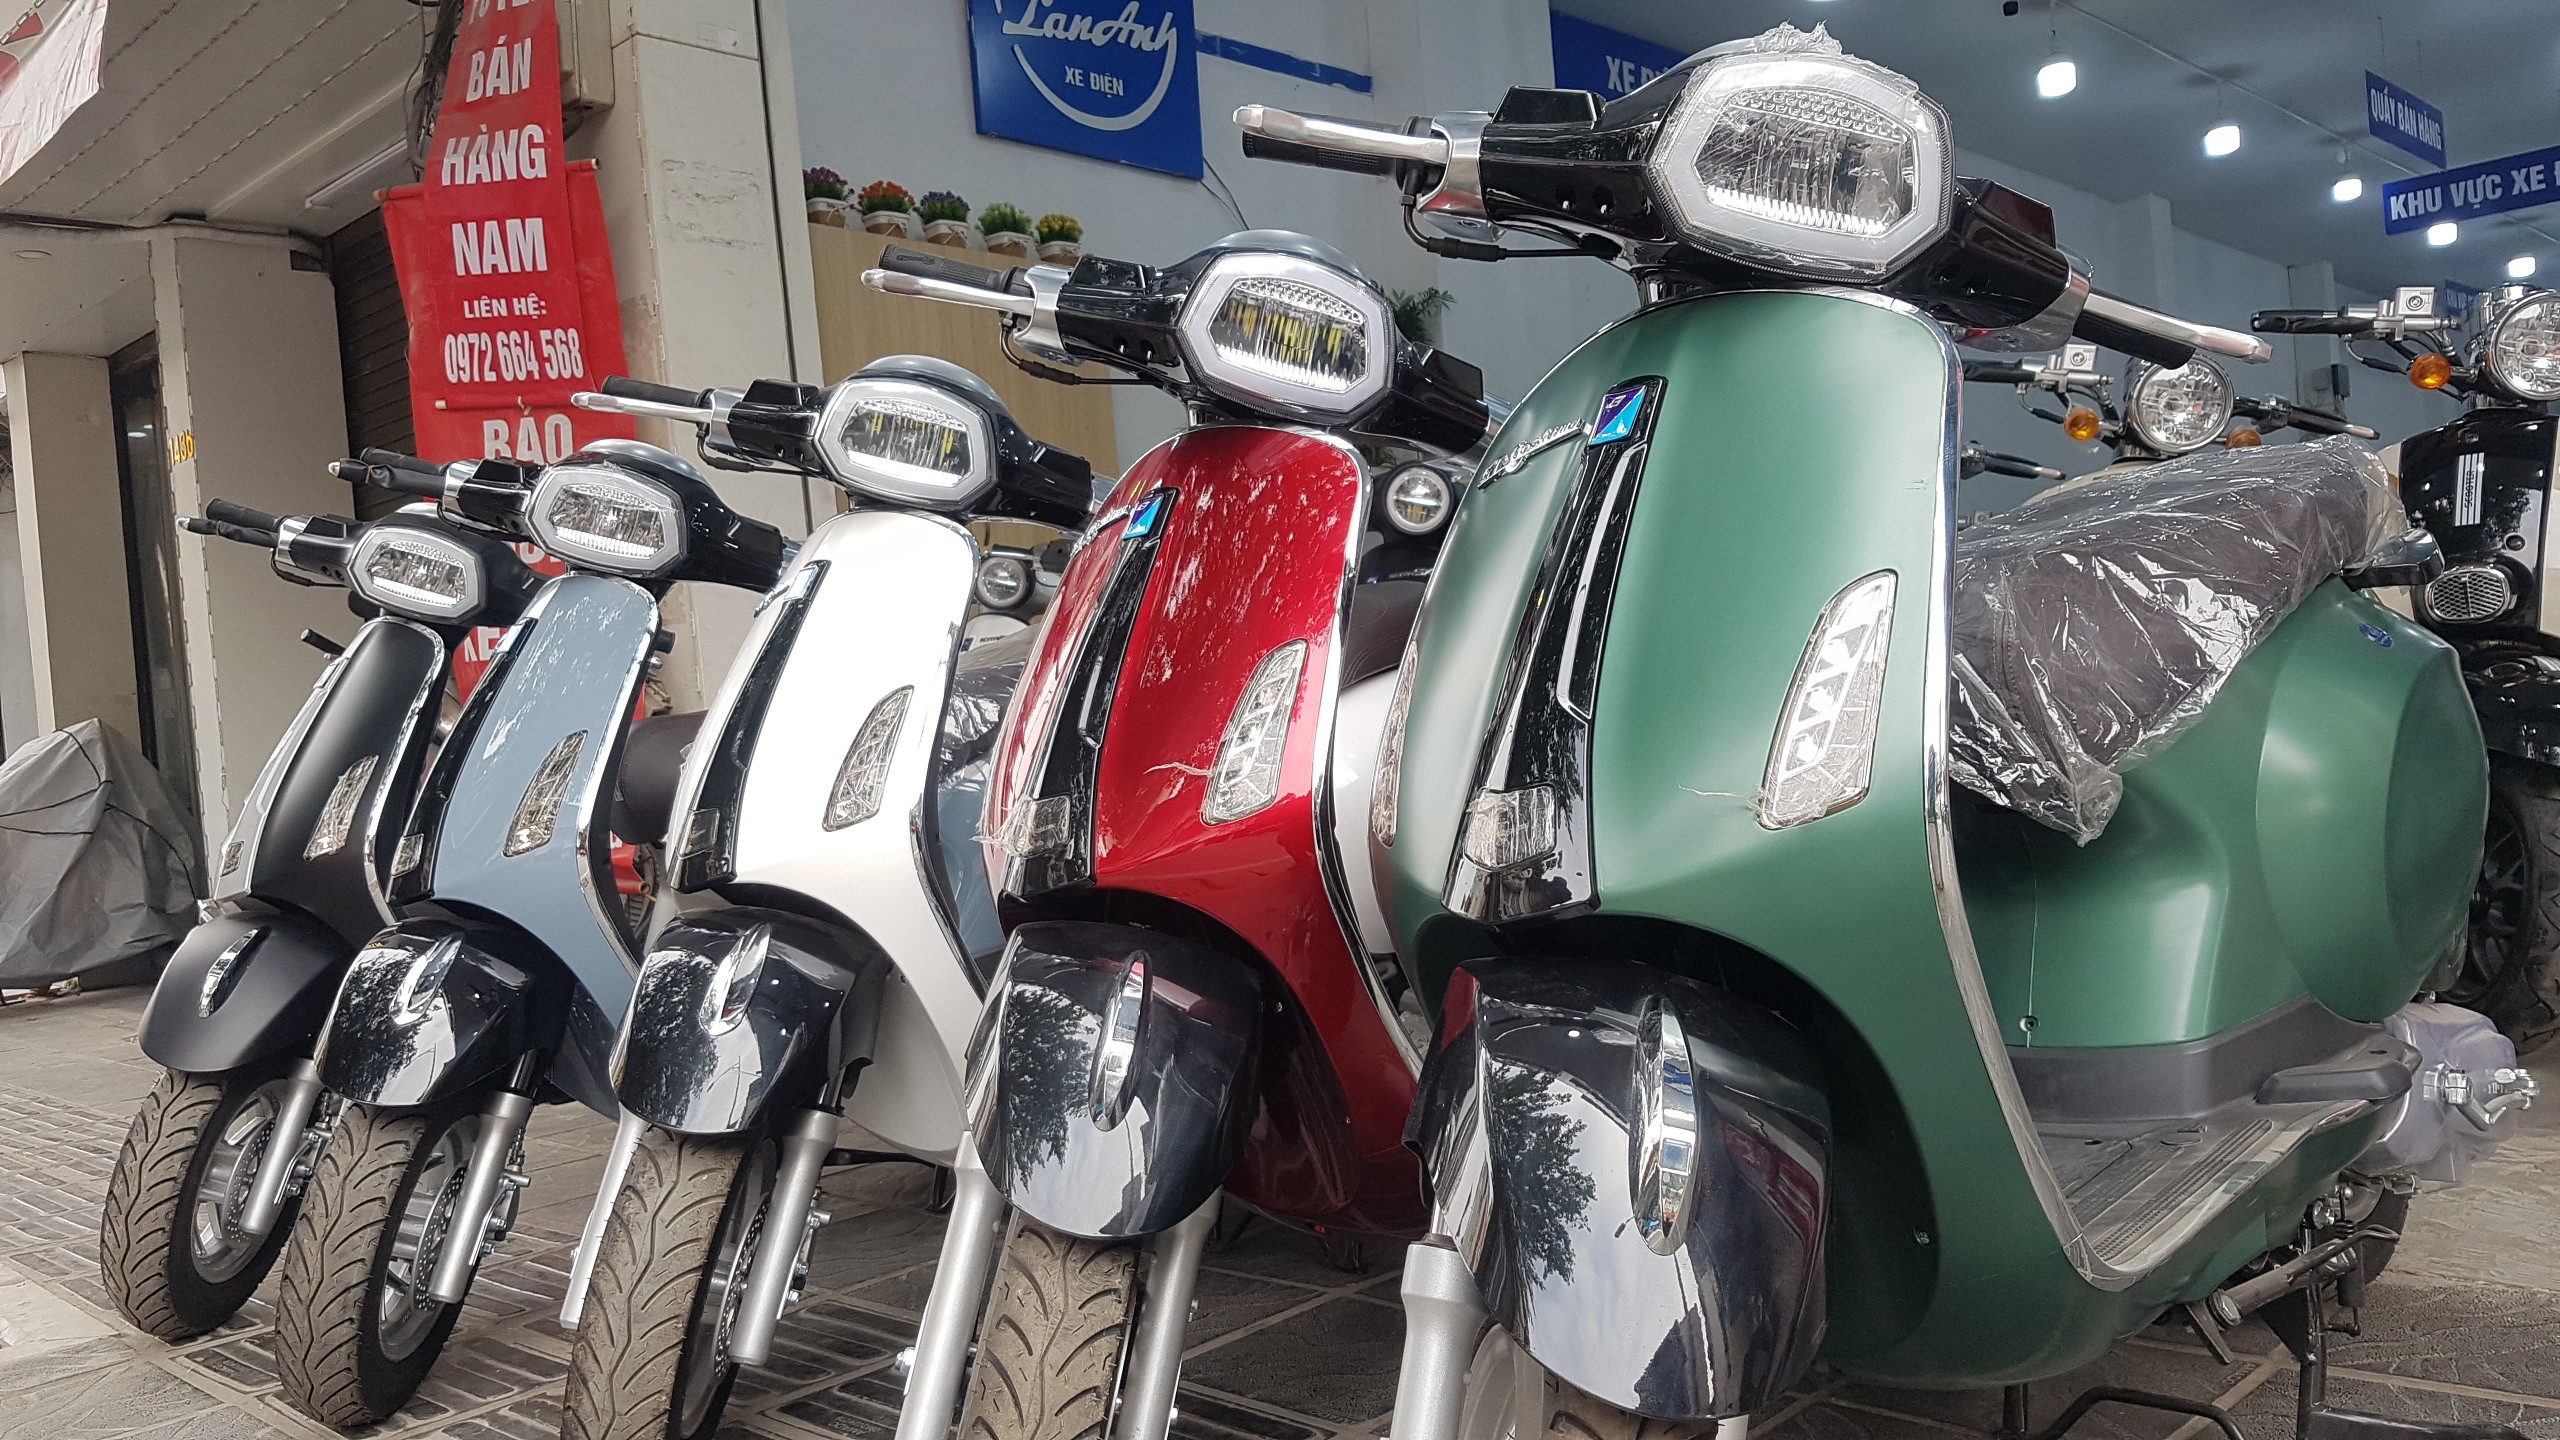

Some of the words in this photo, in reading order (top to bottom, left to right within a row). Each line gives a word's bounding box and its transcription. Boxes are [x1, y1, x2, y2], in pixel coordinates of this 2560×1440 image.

[466, 34, 532, 102] BÁN
[1065, 65, 1084, 87] XE
[1090, 72, 1124, 98] ĐIỆN
[1605, 55, 1636, 93] XE
[2397, 99, 2418, 138] BÁN
[2418, 110, 2442, 151] HÀNG
[442, 123, 548, 186] HÀNG
[2390, 186, 2443, 220] KHU
[2449, 174, 2503, 209] VỰC
[2511, 164, 2547, 196] XE
[452, 217, 548, 277] NAM
[463, 295, 508, 319] LIÊN
[512, 292, 547, 319] HỆ:
[444, 332, 497, 384] 0972
[496, 330, 540, 382] 664
[540, 327, 585, 380] 568
[2464, 470, 2475, 509] SCOOTER
